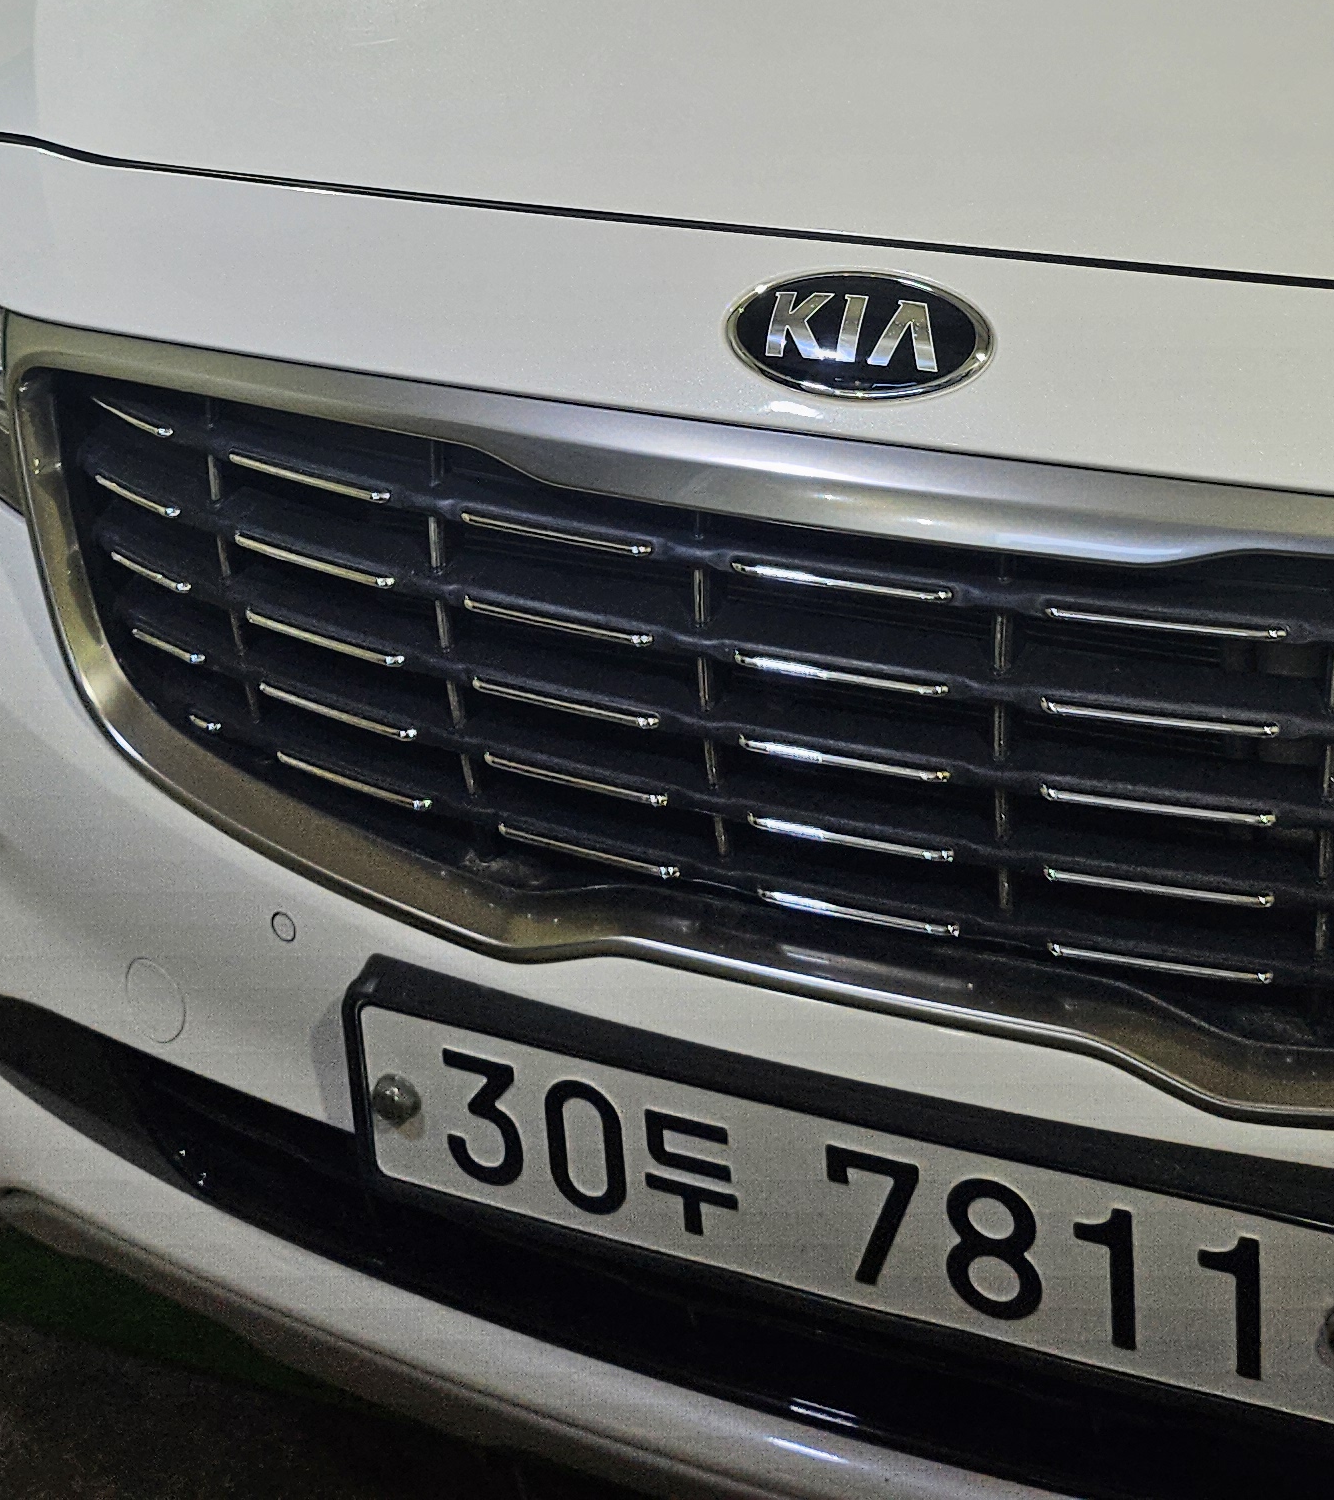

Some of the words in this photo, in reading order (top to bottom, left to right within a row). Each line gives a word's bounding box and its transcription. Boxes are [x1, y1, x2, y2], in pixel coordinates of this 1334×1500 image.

[765, 291, 938, 373] KIA
[441, 1046, 740, 1237] 30두
[824, 1143, 1264, 1382] 7811
